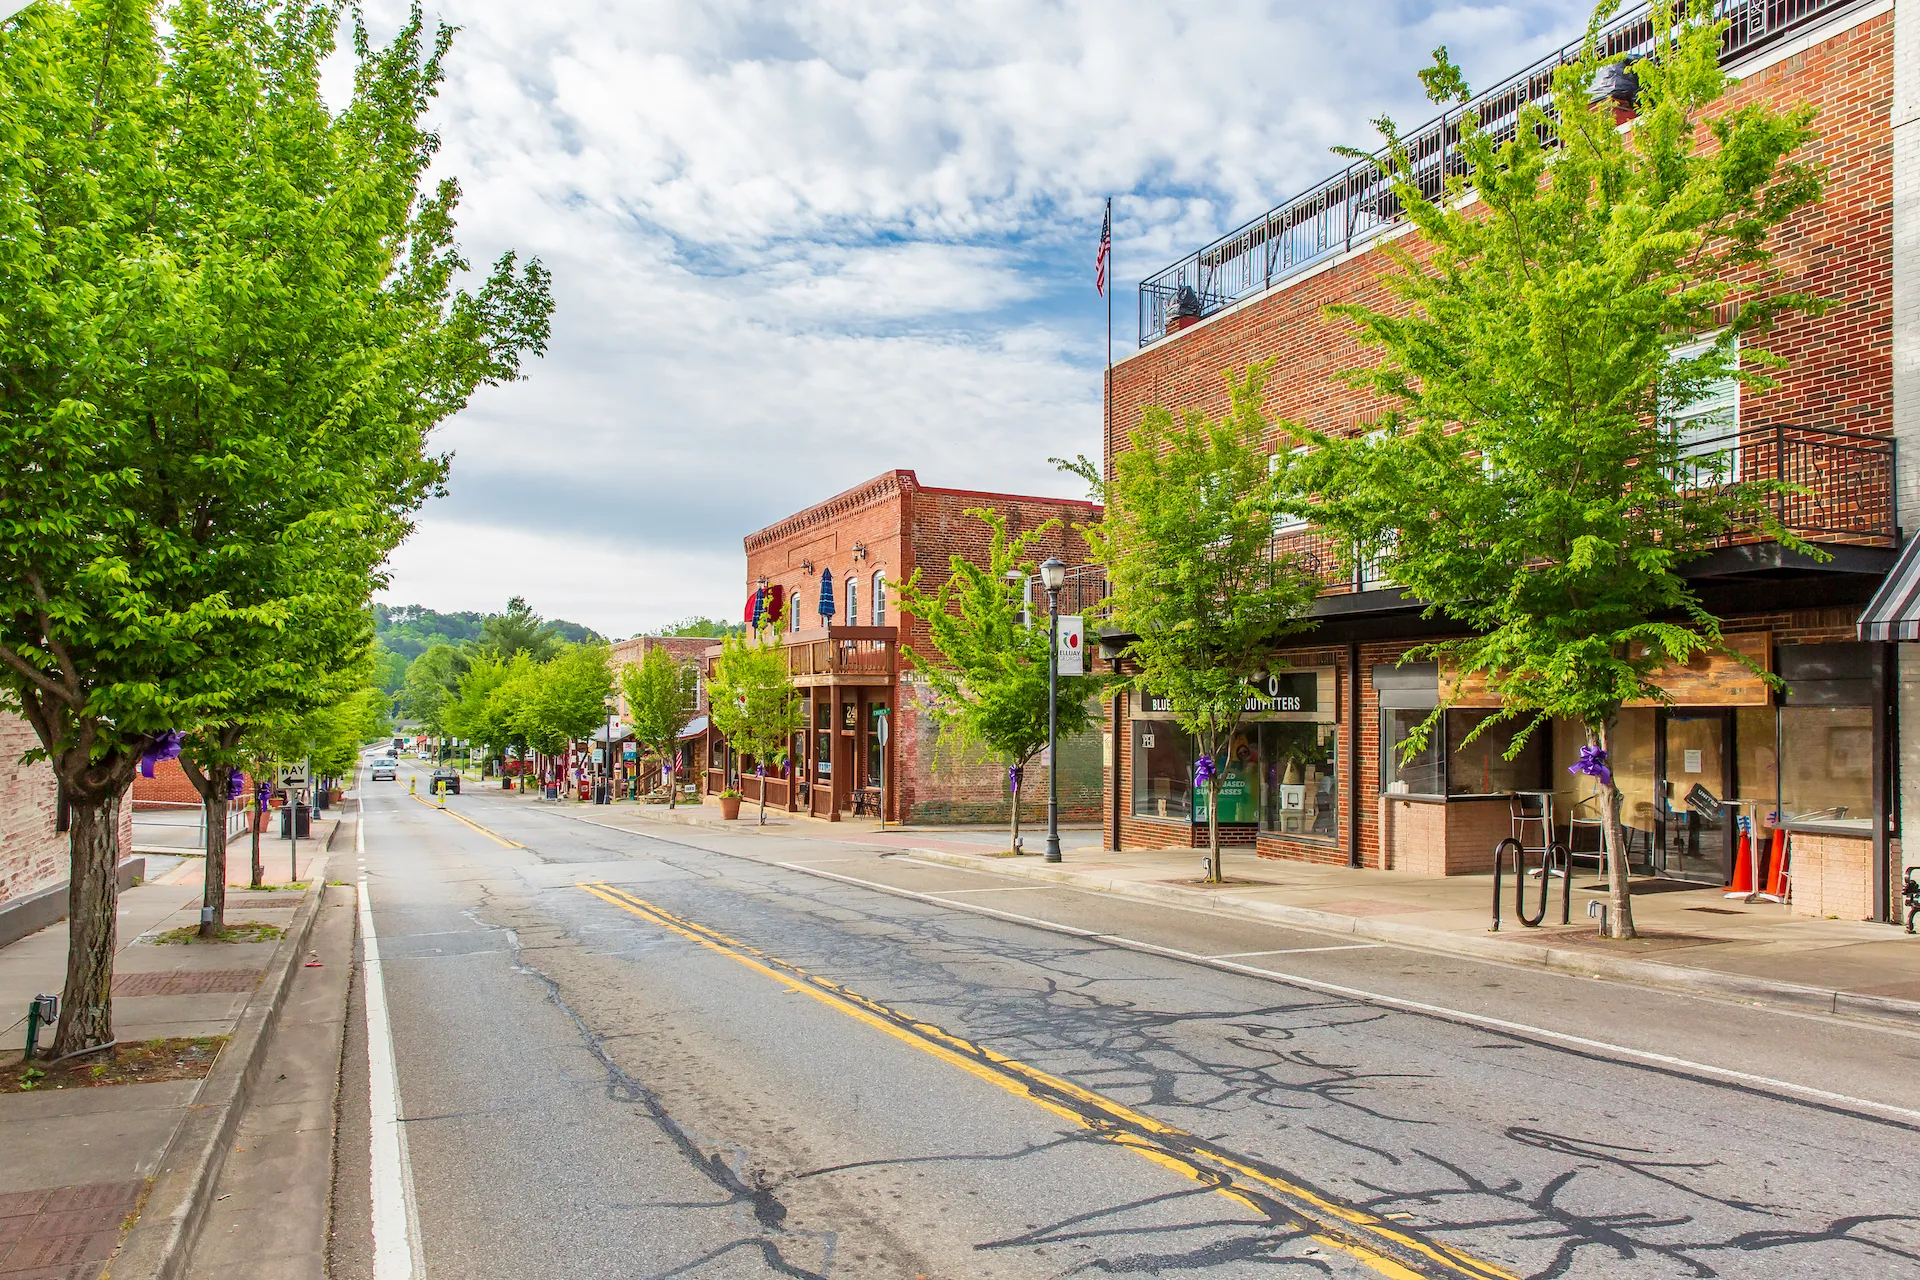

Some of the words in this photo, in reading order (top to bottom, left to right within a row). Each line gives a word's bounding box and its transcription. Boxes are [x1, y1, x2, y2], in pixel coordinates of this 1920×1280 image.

[1152, 699, 1171, 711] BLUE
[873, 708, 887, 716] CHURCH
[281, 765, 305, 775] WAY
[1697, 789, 1719, 808] UNITED
